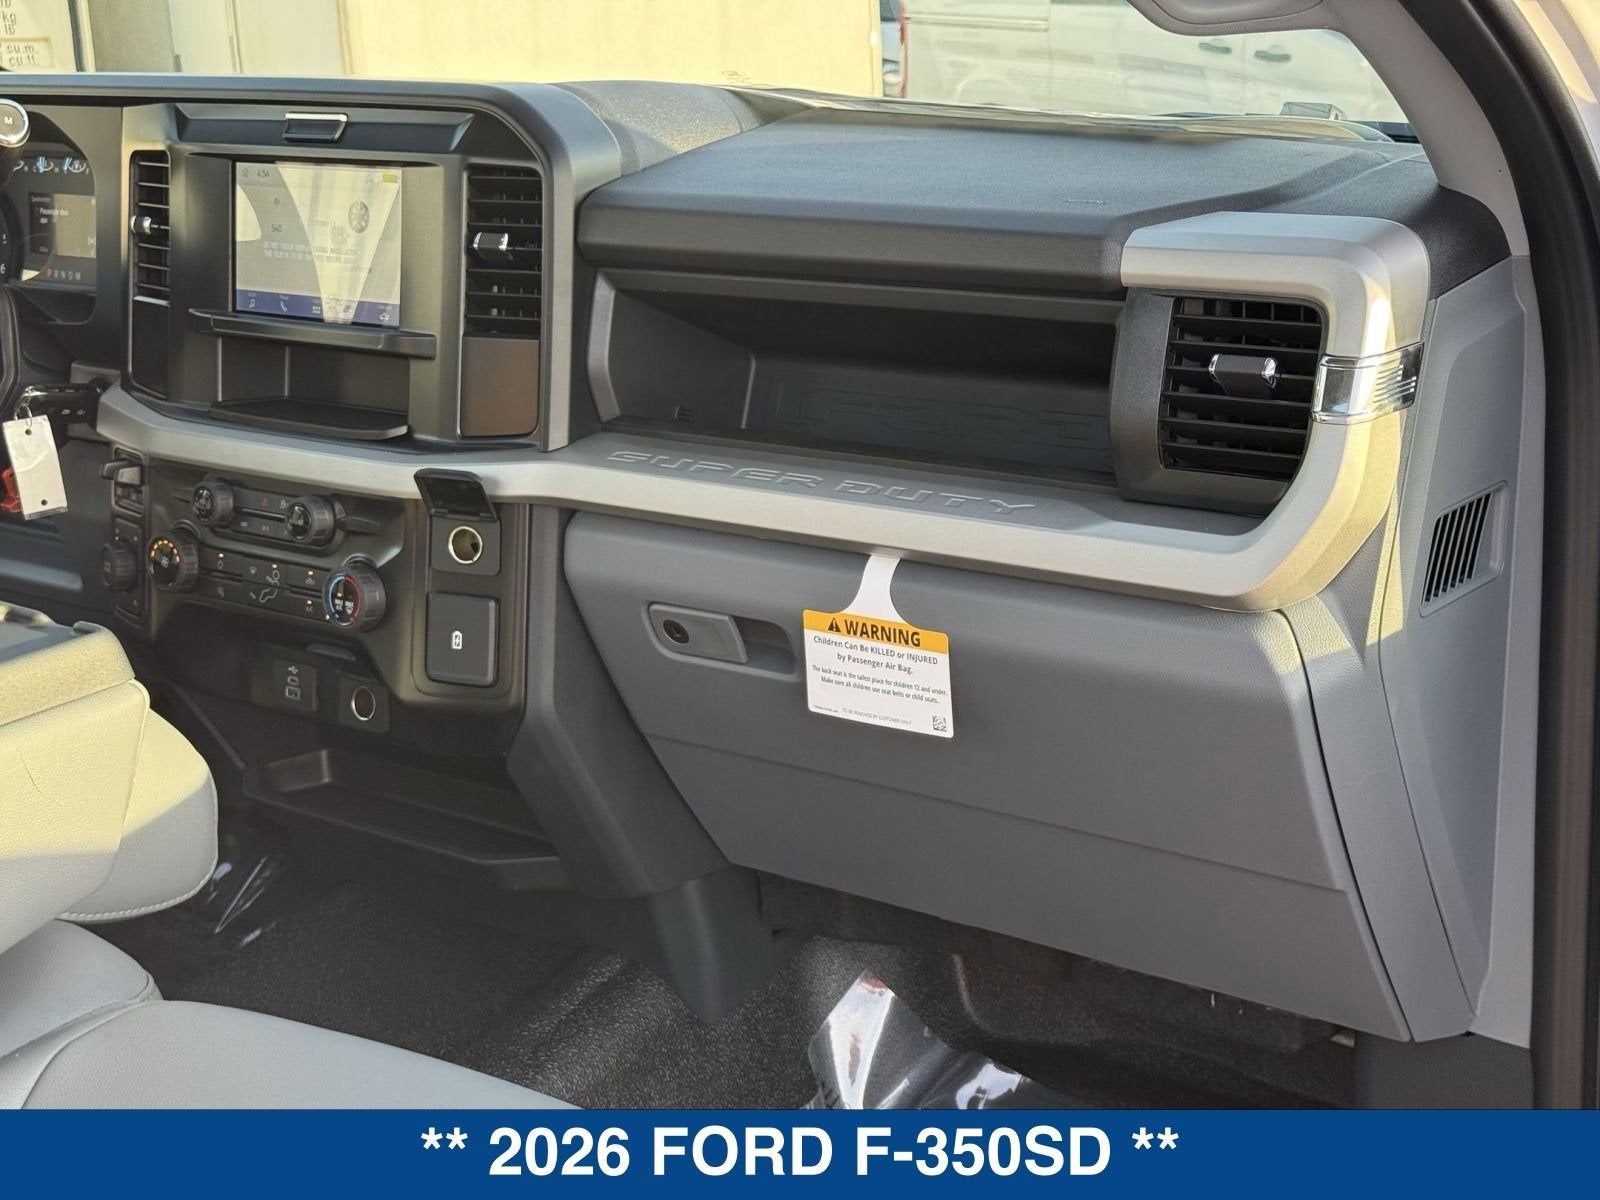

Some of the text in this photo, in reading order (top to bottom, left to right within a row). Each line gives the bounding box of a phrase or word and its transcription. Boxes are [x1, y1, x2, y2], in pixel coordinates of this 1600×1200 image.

[2, 11, 17, 25] kg
[4, 24, 16, 35] lb
[607, 450, 1036, 514] SUPER DUTY
[844, 618, 921, 648] WARNING
[813, 635, 938, 665] Children Can Be KILLED or INJURED
[837, 651, 847, 663] by
[847, 654, 884, 669] Passenger
[885, 661, 898, 671] Air
[812, 664, 821, 672] The
[821, 666, 832, 675] back
[848, 672, 857, 680] the
[857, 673, 871, 682] safest
[871, 676, 885, 685] place
[885, 678, 893, 687] for
[893, 680, 914, 690] children
[821, 676, 834, 684] Make
[852, 682, 872, 691] children
[881, 688, 892, 696] seat
[892, 690, 905, 698] belts
[911, 693, 924, 702] child
